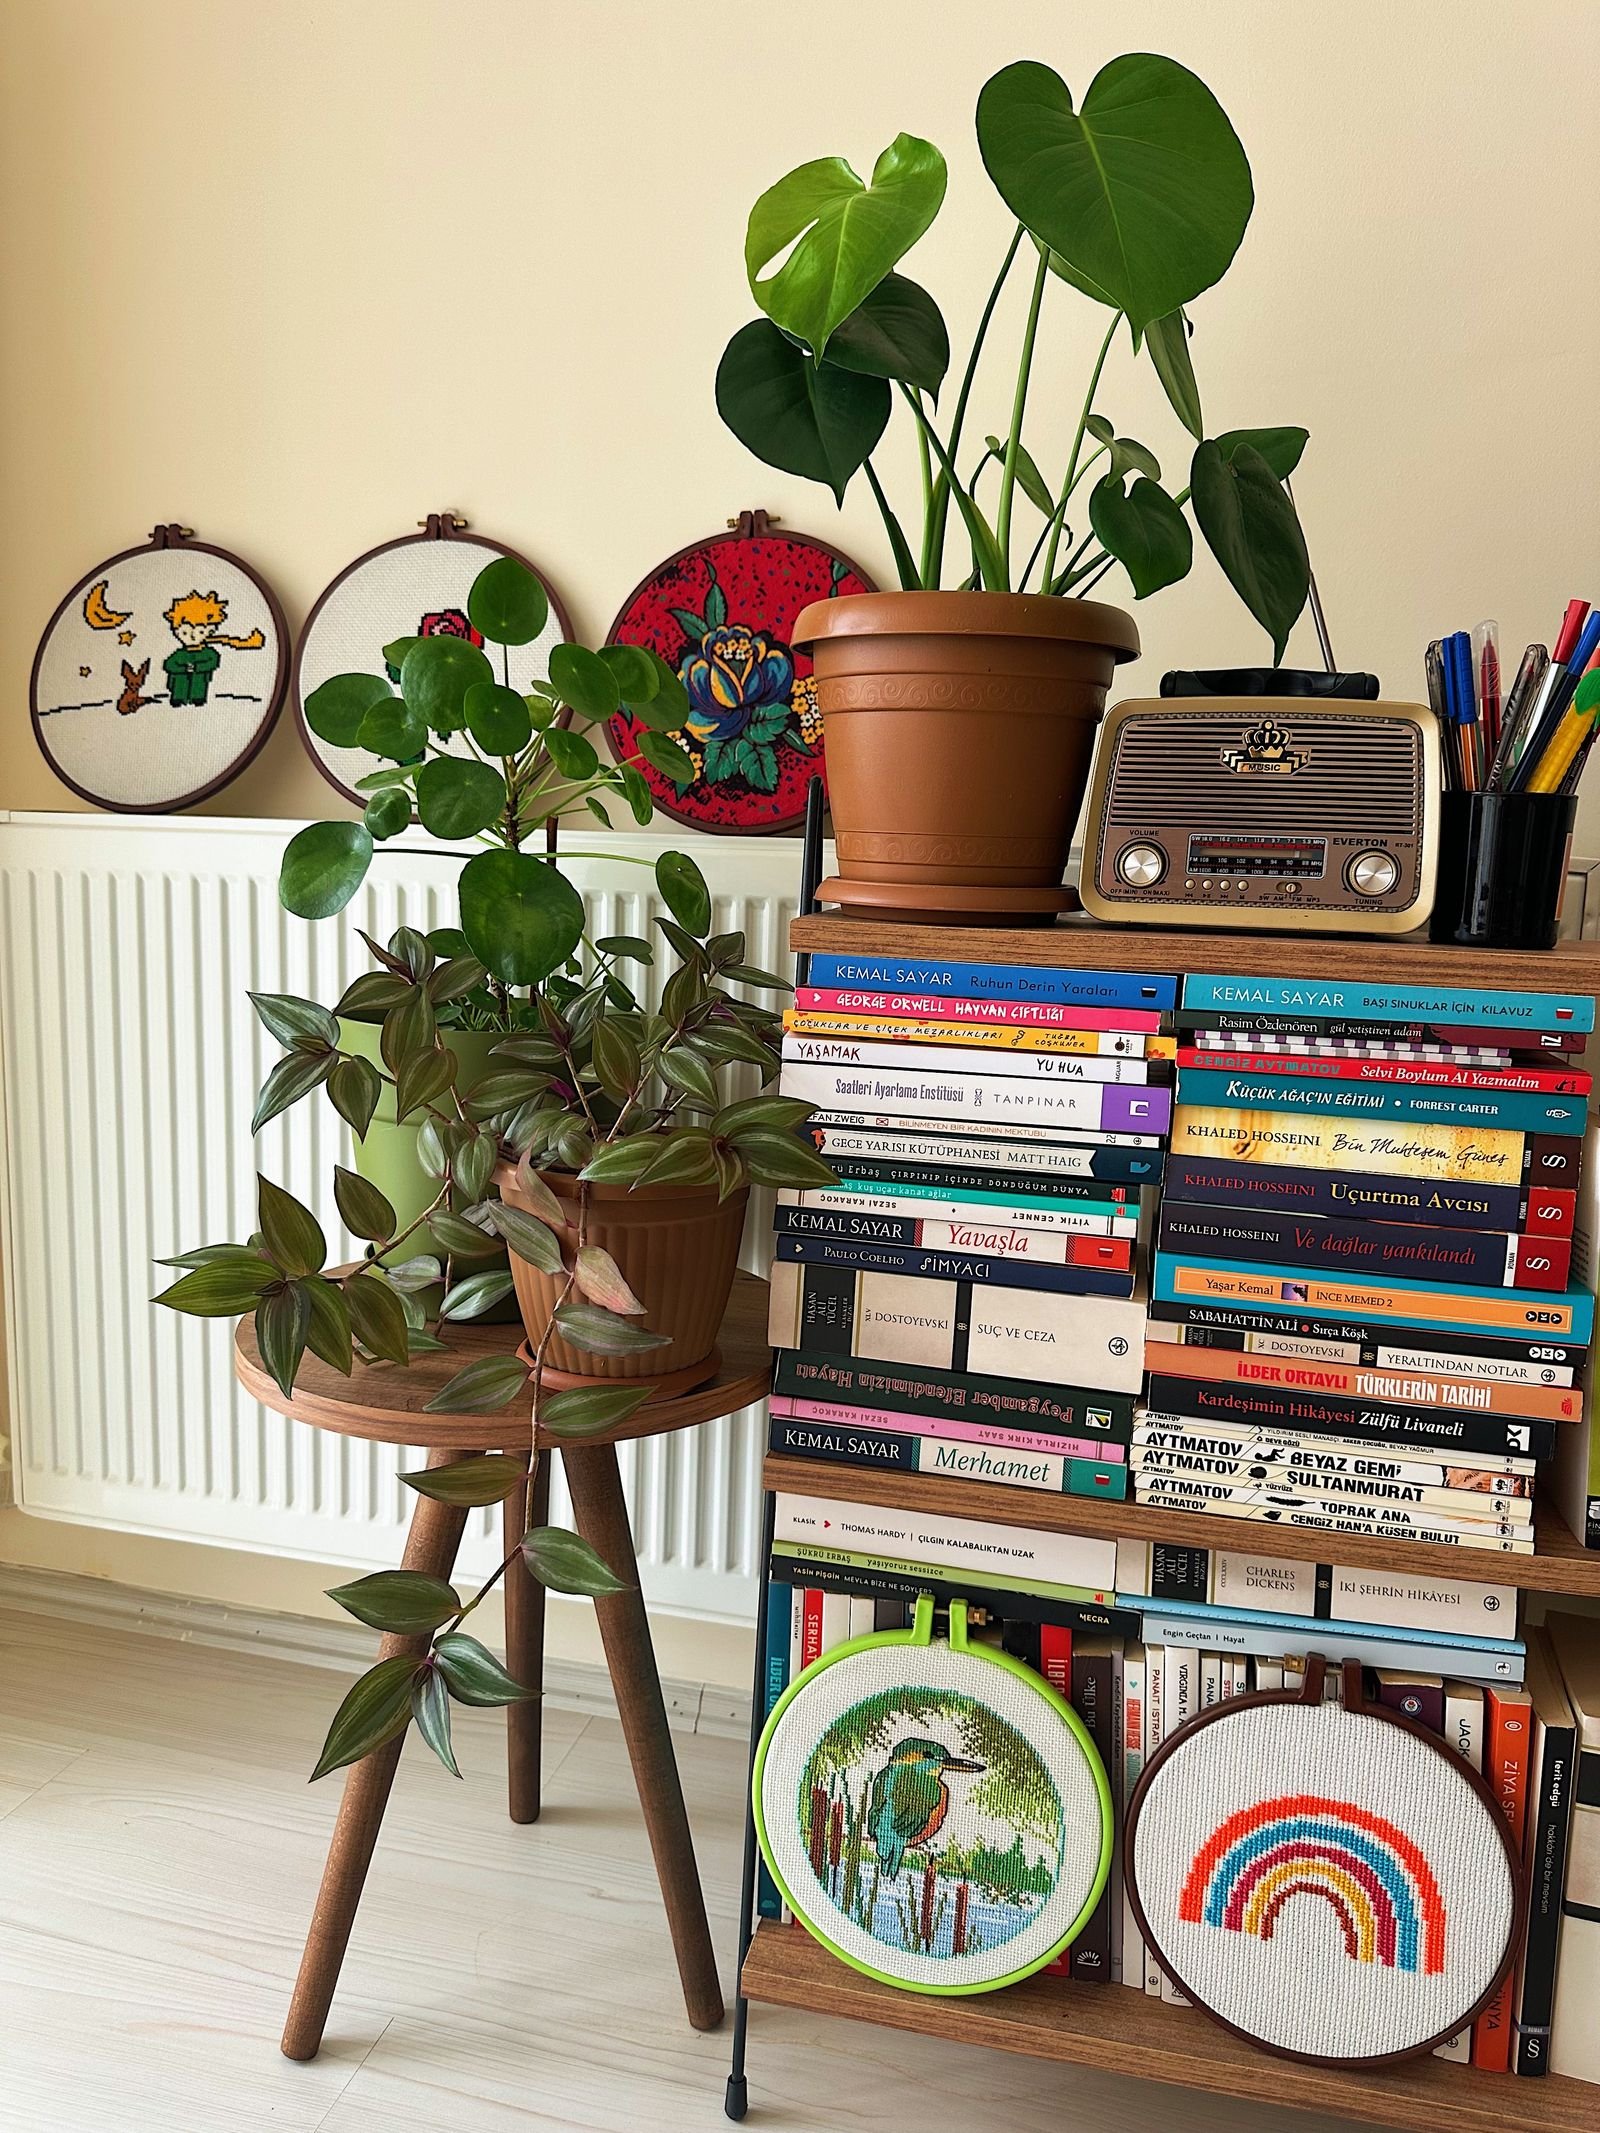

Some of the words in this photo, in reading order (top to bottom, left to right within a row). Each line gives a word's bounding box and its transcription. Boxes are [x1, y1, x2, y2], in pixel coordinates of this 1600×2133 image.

[1248, 763, 1281, 771] MUSIC
[1333, 838, 1388, 847] EVERTON
[836, 965, 891, 982] KEMAL
[896, 969, 952, 986] SAYAR
[970, 976, 1013, 990] Ruhun
[1019, 979, 1056, 992] Derin
[1062, 982, 1118, 996] Yaraları
[836, 993, 887, 1009] GEORGE
[891, 998, 945, 1012] ORWELL
[955, 1002, 1006, 1018] HAYVAN
[1212, 986, 1275, 1003] KEMAL
[1280, 990, 1344, 1008] SAYAR
[1362, 996, 1388, 1008] BAŞI
[1391, 1000, 1448, 1012] SINUKLAR
[1452, 1002, 1475, 1014] İÇİN
[1482, 1005, 1533, 1017] KILAVUZ
[1219, 1016, 1254, 1030] Rasim
[1256, 1016, 1318, 1033] Özdenören
[1330, 1024, 1346, 1035] gül
[1347, 1024, 1391, 1036] yetiştiren
[1393, 1026, 1422, 1038] adam
[798, 1042, 860, 1060] YAŞAMAK
[1036, 1058, 1054, 1072] YU
[1058, 1061, 1084, 1076] HUA
[1194, 1054, 1250, 1067] CENGİZ
[1255, 1060, 1341, 1075] AYTMATOV
[1360, 1064, 1393, 1079] Selvi
[1396, 1068, 1449, 1084] Boylum
[1451, 1072, 1468, 1084] Al
[1471, 1072, 1540, 1089] Yazmalım
[836, 1078, 872, 1096] Saatleri
[874, 1083, 918, 1100] Ayarlama
[920, 1084, 964, 1102] Enstitüsü
[994, 1094, 1076, 1108] TANPINAR
[1335, 1092, 1386, 1108] EĞİTİMİ
[1410, 1100, 1456, 1112] FORREST
[1458, 1104, 1499, 1115] CARTER
[834, 1114, 865, 1124] ZWEIG
[1004, 1128, 1046, 1137] MEKTUBU
[1186, 1125, 1248, 1140] KHALED
[1251, 1130, 1321, 1146] HOSSEINI
[1332, 1133, 1367, 1153] Bin
[832, 1137, 862, 1149] GECE
[865, 1140, 906, 1152] YARISI
[909, 1142, 1000, 1160] KÜTÜPHANESİ
[1006, 1152, 1046, 1164] MATT
[1048, 1154, 1081, 1167] HAIG
[848, 1165, 880, 1177] Erbaş
[820, 1193, 865, 1206] KARAKOÇ
[876, 1185, 896, 1194] uçar
[899, 1186, 926, 1197] kanat
[928, 1190, 952, 1200] ağlar
[1184, 1174, 1244, 1190] KHALED
[1248, 1180, 1316, 1196] HOSSEINI
[1330, 1182, 1420, 1208] Uçurtma
[1426, 1191, 1490, 1214] Avcısı
[786, 1212, 847, 1233] KEMAL
[850, 1218, 902, 1239] SAYAR
[1012, 1212, 1054, 1222] CENNET
[948, 1224, 1028, 1254] Yavaşla
[1169, 1222, 1220, 1236] KHALED
[1222, 1228, 1280, 1243] HOSSEINI
[1294, 1226, 1316, 1249] Ve
[1321, 1233, 1378, 1256] dağlar
[1382, 1242, 1476, 1265] yankılandı
[920, 1255, 989, 1278] SİMYACI
[1206, 1278, 1236, 1292] Yaşar
[1238, 1282, 1274, 1296] Kemal
[1344, 1294, 1385, 1307] MEMED
[1386, 1298, 1393, 1308] 2
[807, 1291, 816, 1324] HASAN
[826, 1295, 837, 1325] YÜCEL
[978, 1324, 1002, 1338] SUÇ
[1005, 1327, 1020, 1338] VE
[1024, 1330, 1056, 1343] CEZA
[1189, 1308, 1274, 1330] SABAHATTİN
[1276, 1318, 1298, 1332] ALİ
[1312, 1323, 1339, 1338] Sırça
[1341, 1326, 1368, 1340] Köşk
[1258, 1338, 1264, 1350] XC
[796, 1363, 854, 1388] Hayatı
[1387, 1353, 1474, 1374] YERALTINDAN
[1476, 1364, 1528, 1378] NOTLAR
[858, 1372, 967, 1406] Efendimizin
[1237, 1360, 1282, 1380] İLBER
[1285, 1368, 1348, 1389] ORTAYLI
[1355, 1373, 1438, 1402] TÜRKLERİN
[1441, 1384, 1492, 1408] TARİHİ
[971, 1390, 1074, 1424] Peygamber
[1146, 1412, 1180, 1422] AYTMATOV
[1197, 1391, 1287, 1415] Kardeşimin
[1290, 1402, 1356, 1424] Hikâyesi
[1359, 1411, 1400, 1432] Zülfü
[1403, 1416, 1464, 1438] Livaneli
[978, 1430, 1004, 1440] SAAT
[1146, 1420, 1184, 1432] AYTMATOV
[784, 1428, 844, 1452] KEMAL
[847, 1437, 900, 1460] SAYAR
[1008, 1434, 1033, 1444] KIRK
[1146, 1431, 1244, 1457] AYTMATOV
[1290, 1451, 1348, 1472] BEYAZ
[933, 1446, 1050, 1482] Merhamet
[1142, 1464, 1175, 1474] AYTMATOV
[1143, 1449, 1240, 1476] AYTMATOV
[1286, 1470, 1425, 1502] SULTANMURAT
[1149, 1478, 1234, 1500] AYTMATOV
[1320, 1500, 1376, 1520] TOPRAK
[1381, 1508, 1411, 1524] ANA
[1148, 1494, 1207, 1511] AYTMATOV
[1291, 1513, 1333, 1528] CENGİZ
[1336, 1520, 1372, 1534] HAN'A
[1376, 1523, 1417, 1539] KÜSEN
[1420, 1530, 1460, 1544] BULUT
[840, 1522, 876, 1536] THOMAS
[878, 1528, 906, 1540] HARDY
[918, 1534, 944, 1546] ÇILGIN
[946, 1538, 1010, 1556] KALABALIKTAN
[1012, 1548, 1035, 1559] UZAK
[866, 1557, 907, 1572] yaşıyoruz
[1154, 1547, 1166, 1584] HASAN
[1177, 1552, 1188, 1584] YÜCEL
[1246, 1566, 1296, 1580] CHARLES
[844, 1575, 869, 1586] MEVLA
[888, 1582, 898, 1590] NE
[1246, 1578, 1296, 1592] DICKENS
[1340, 1580, 1356, 1592] İKİ
[1360, 1583, 1404, 1599] ŞEHRİN
[1407, 1589, 1461, 1605] HİKÂYESİ
[1079, 1612, 1110, 1624] MECRA
[1162, 1628, 1184, 1638] Engin
[1185, 1630, 1212, 1641] Geçtan
[1223, 1635, 1246, 1644] Hayat
[1082, 1676, 1097, 1708] Ülke
[1152, 1669, 1160, 1704] PANAIT
[1178, 1664, 1188, 1704] VIRGINIA
[1458, 1718, 1471, 1758] JACK
[1503, 1759, 1518, 1796] ZİYA
[1552, 1760, 1564, 1780] ferit
[1550, 1782, 1562, 1808] edgü
